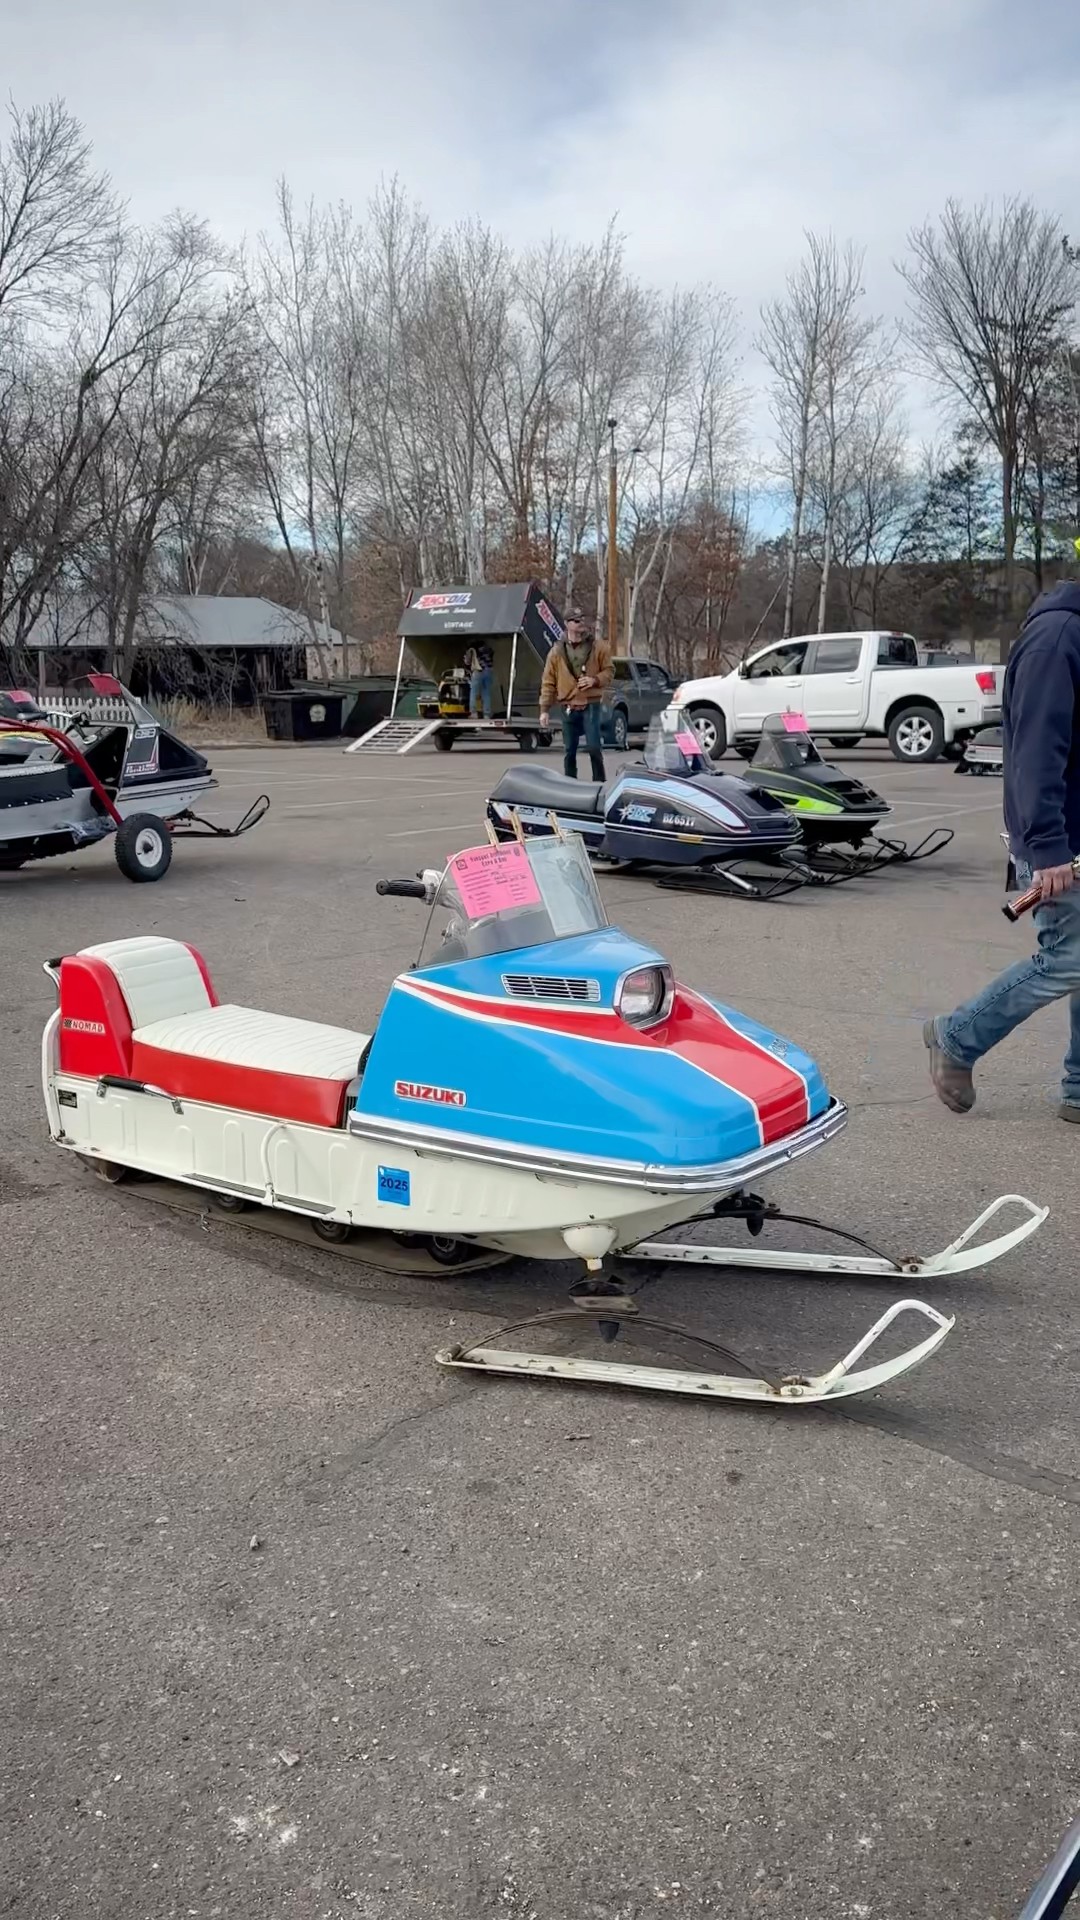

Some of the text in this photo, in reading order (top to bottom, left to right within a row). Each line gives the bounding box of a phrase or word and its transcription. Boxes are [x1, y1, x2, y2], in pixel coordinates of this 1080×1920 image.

[72, 1019, 104, 1033] NOMAD
[396, 1081, 465, 1106] SUZUKI
[380, 1176, 409, 1192] 2025
